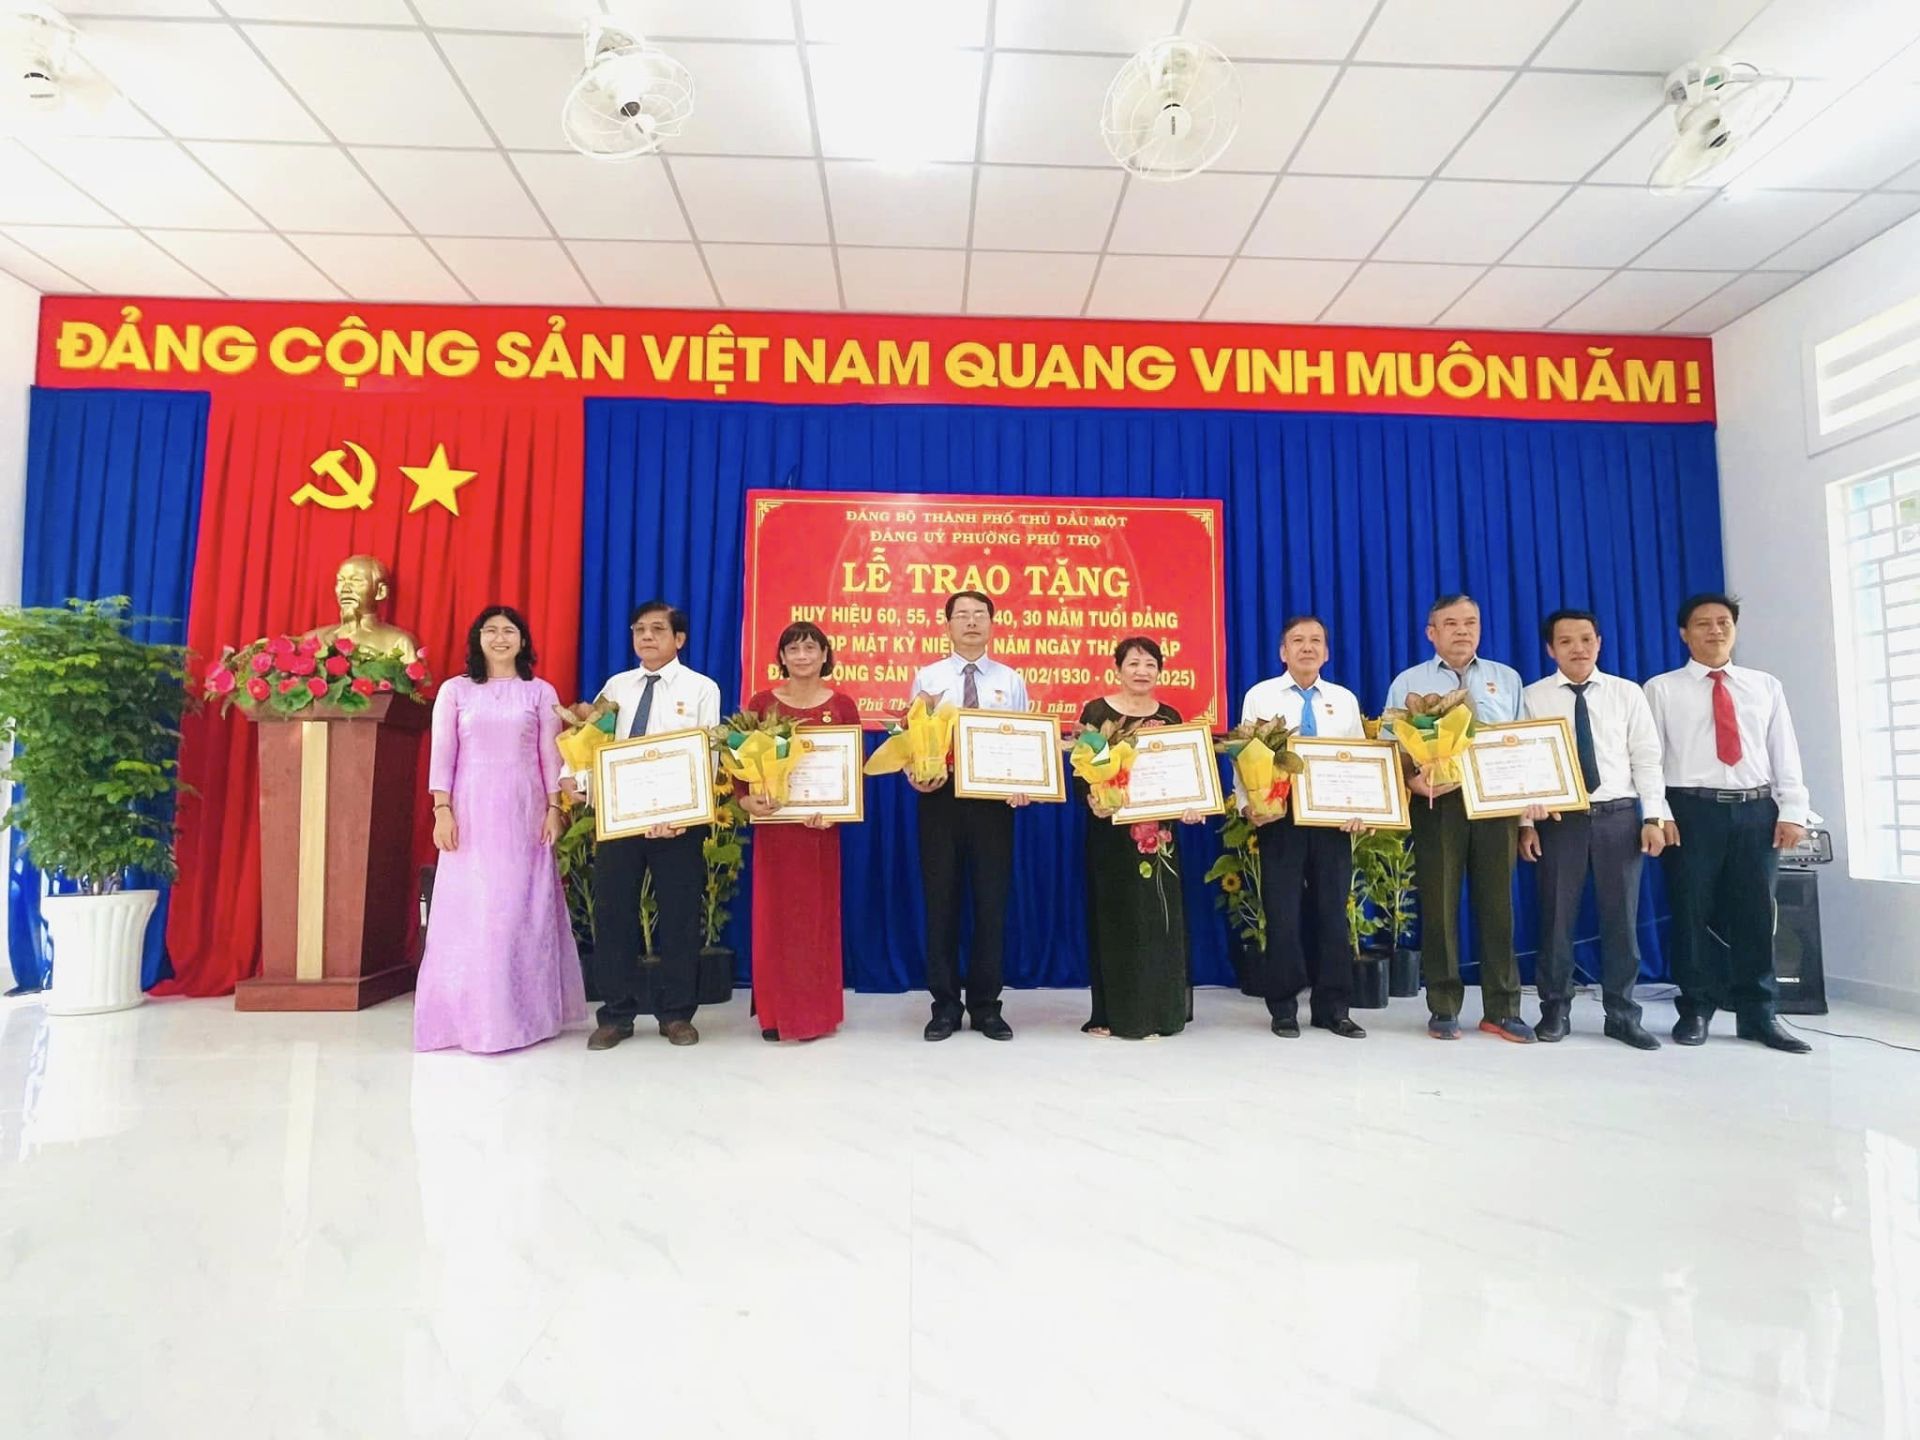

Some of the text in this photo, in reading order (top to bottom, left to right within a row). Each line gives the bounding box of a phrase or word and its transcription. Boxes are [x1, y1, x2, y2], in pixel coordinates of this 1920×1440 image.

[56, 306, 258, 374] ĐẢNG
[268, 314, 482, 389] CỘNG
[495, 314, 625, 380] SẢN
[641, 324, 769, 395] VIỆT
[783, 338, 931, 386] NAM
[944, 342, 1178, 391] QUANG
[1190, 347, 1335, 396] VINH
[1347, 341, 1529, 402] MUÔN
[1536, 347, 1677, 404] NĂM
[896, 509, 916, 524] BỘ
[982, 511, 1014, 525] PHỐ
[1093, 515, 1128, 529] MỘT
[1066, 534, 1102, 548] THỌ
[842, 547, 1130, 604] LỄ TRAO TẶNG
[791, 606, 826, 623] HUY
[832, 604, 871, 627] HIỆU
[877, 609, 901, 625] 60,
[906, 609, 931, 627] 55,
[1023, 611, 1042, 626] 30
[1047, 606, 1084, 628] NĂM
[1089, 604, 1127, 629] TUỔI
[1132, 607, 1179, 629] ĐẢNG
[852, 632, 887, 657] MẶT
[922, 634, 953, 658] NIỆ
[993, 634, 1030, 656] NĂM
[1036, 635, 1081, 657] NGÀY
[874, 659, 908, 683] SẢN
[857, 697, 883, 712] Phú
